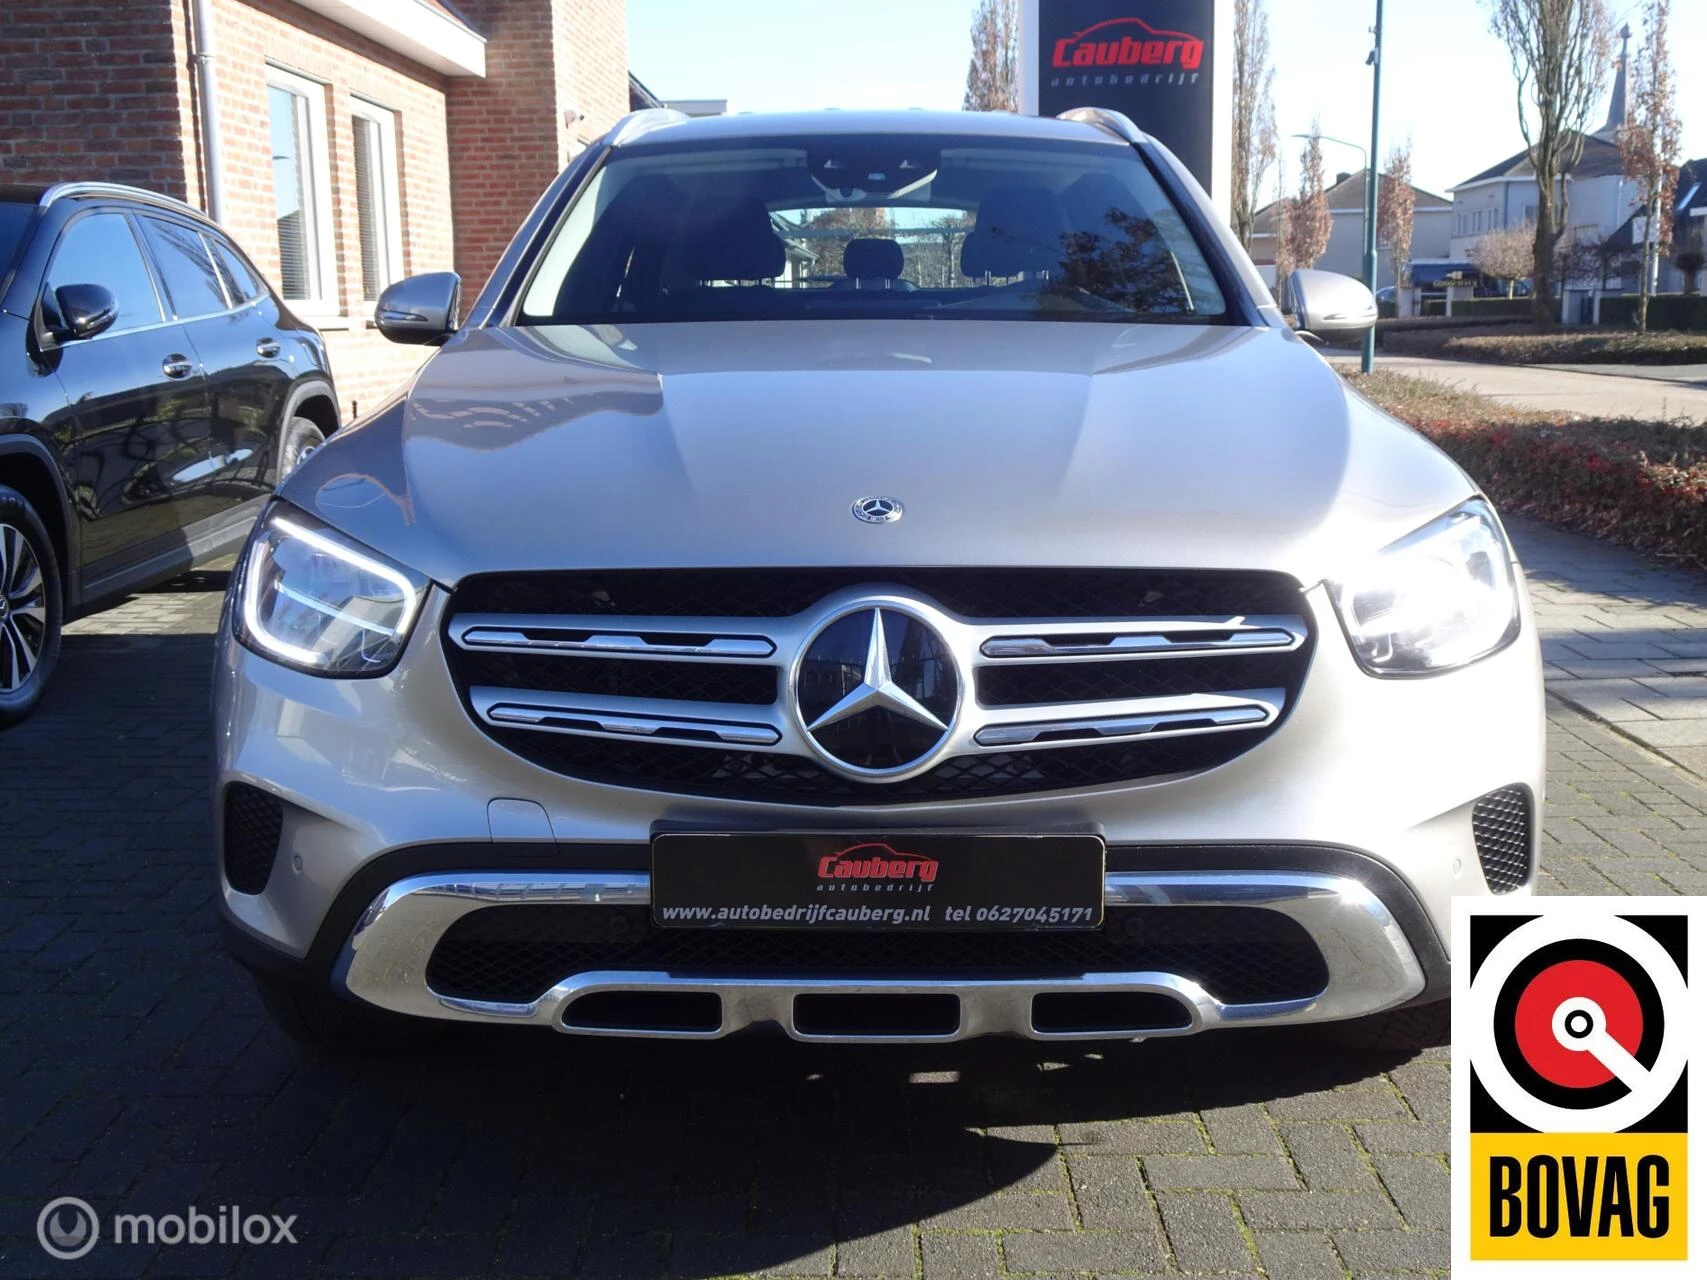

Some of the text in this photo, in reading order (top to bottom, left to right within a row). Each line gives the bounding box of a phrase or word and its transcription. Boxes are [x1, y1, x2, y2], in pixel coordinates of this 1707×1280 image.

[1053, 36, 1204, 70] Cauberg
[1050, 72, 1199, 87] autobedrijf
[817, 856, 939, 883] Cauberg
[816, 883, 933, 893] autobedrijf
[662, 904, 1093, 924] www.autobedrijfcauberg.nl tel 0627045171
